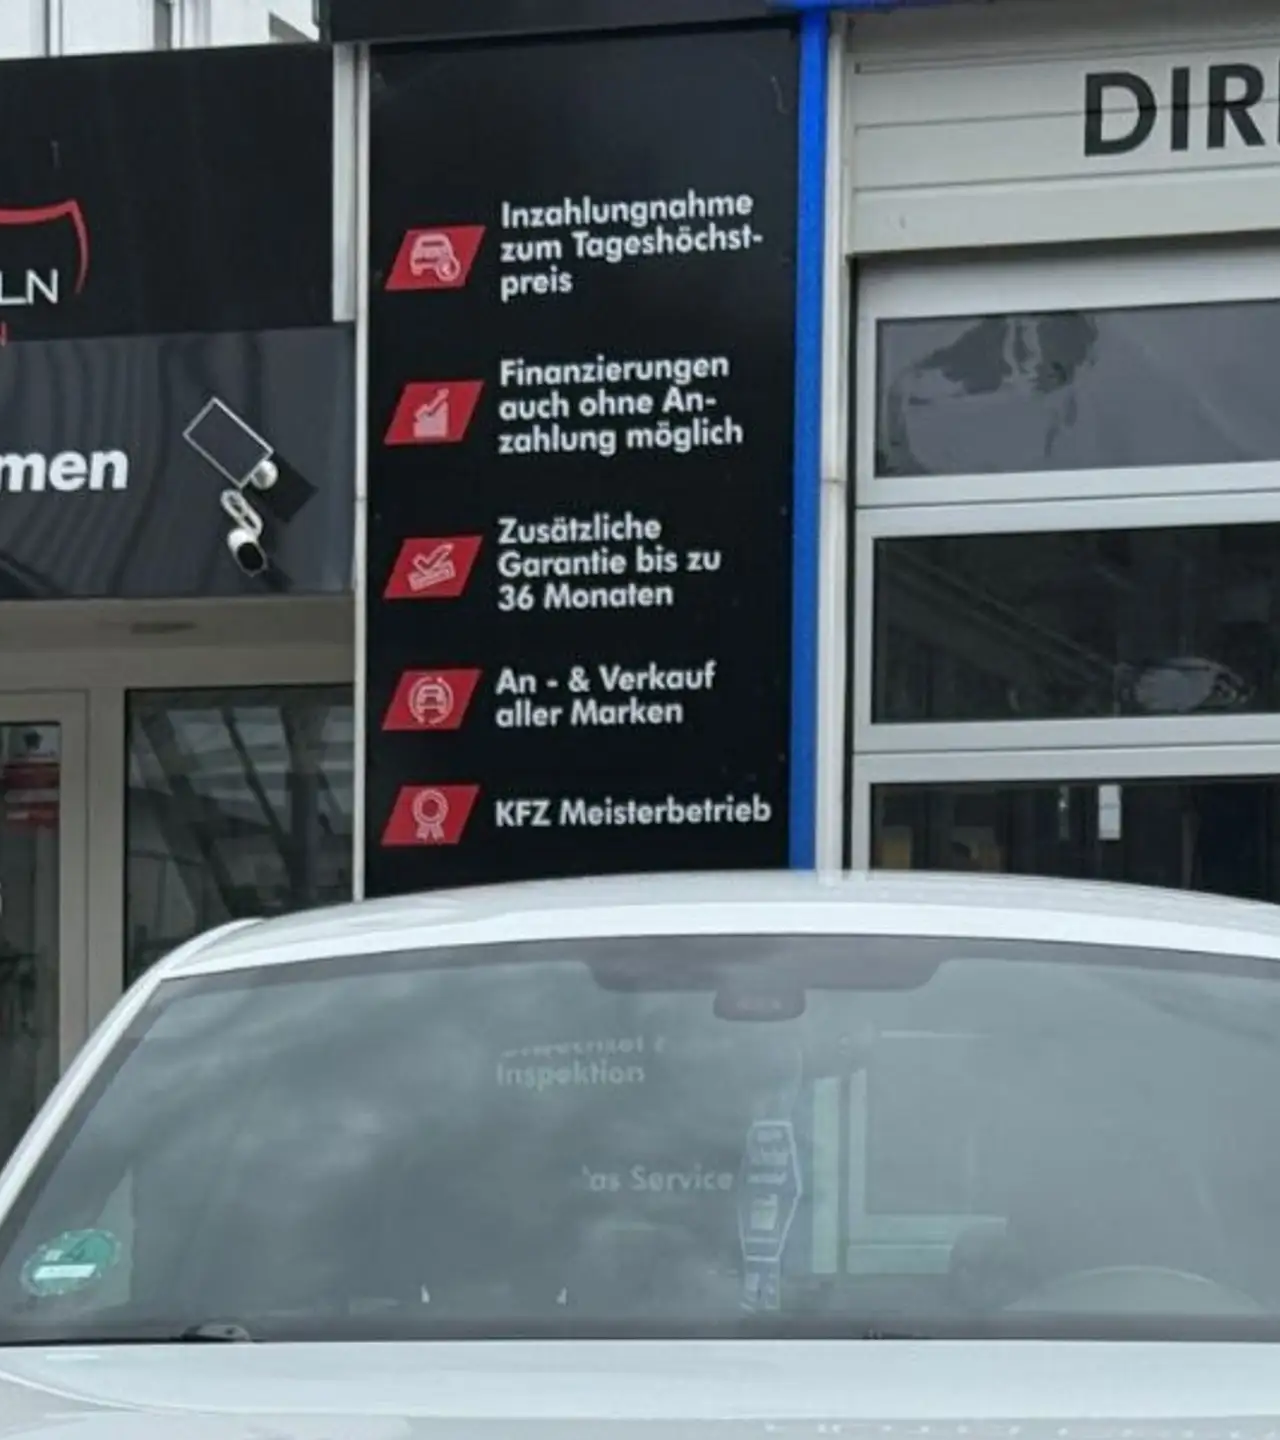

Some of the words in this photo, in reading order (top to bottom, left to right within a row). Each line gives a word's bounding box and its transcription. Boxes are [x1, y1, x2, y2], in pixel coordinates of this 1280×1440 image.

[501, 189, 753, 230] Inzahlungnahme
[500, 237, 562, 262] zum
[572, 222, 763, 262] Tageshöchst-
[500, 267, 573, 301] preis
[500, 354, 729, 387] Finanzierungen
[499, 393, 569, 421] auch
[579, 390, 653, 418] ohne
[662, 386, 716, 413] An-
[498, 421, 617, 457] zahlung
[627, 417, 743, 453] möglich
[497, 513, 661, 545] Zusätzliche
[497, 547, 626, 578] Garantie
[635, 545, 677, 573] bis
[687, 549, 721, 572] zu
[497, 585, 534, 611] 36
[543, 582, 673, 610] Monaten
[567, 665, 590, 692] &
[599, 660, 717, 692] Verkauf
[495, 699, 562, 728] aller
[570, 698, 683, 727] Marken
[495, 800, 551, 827] KFZ
[559, 794, 772, 826] Meisterbetrieb
[496, 1059, 645, 1092] Inspektion
[630, 1162, 734, 1192] Service
